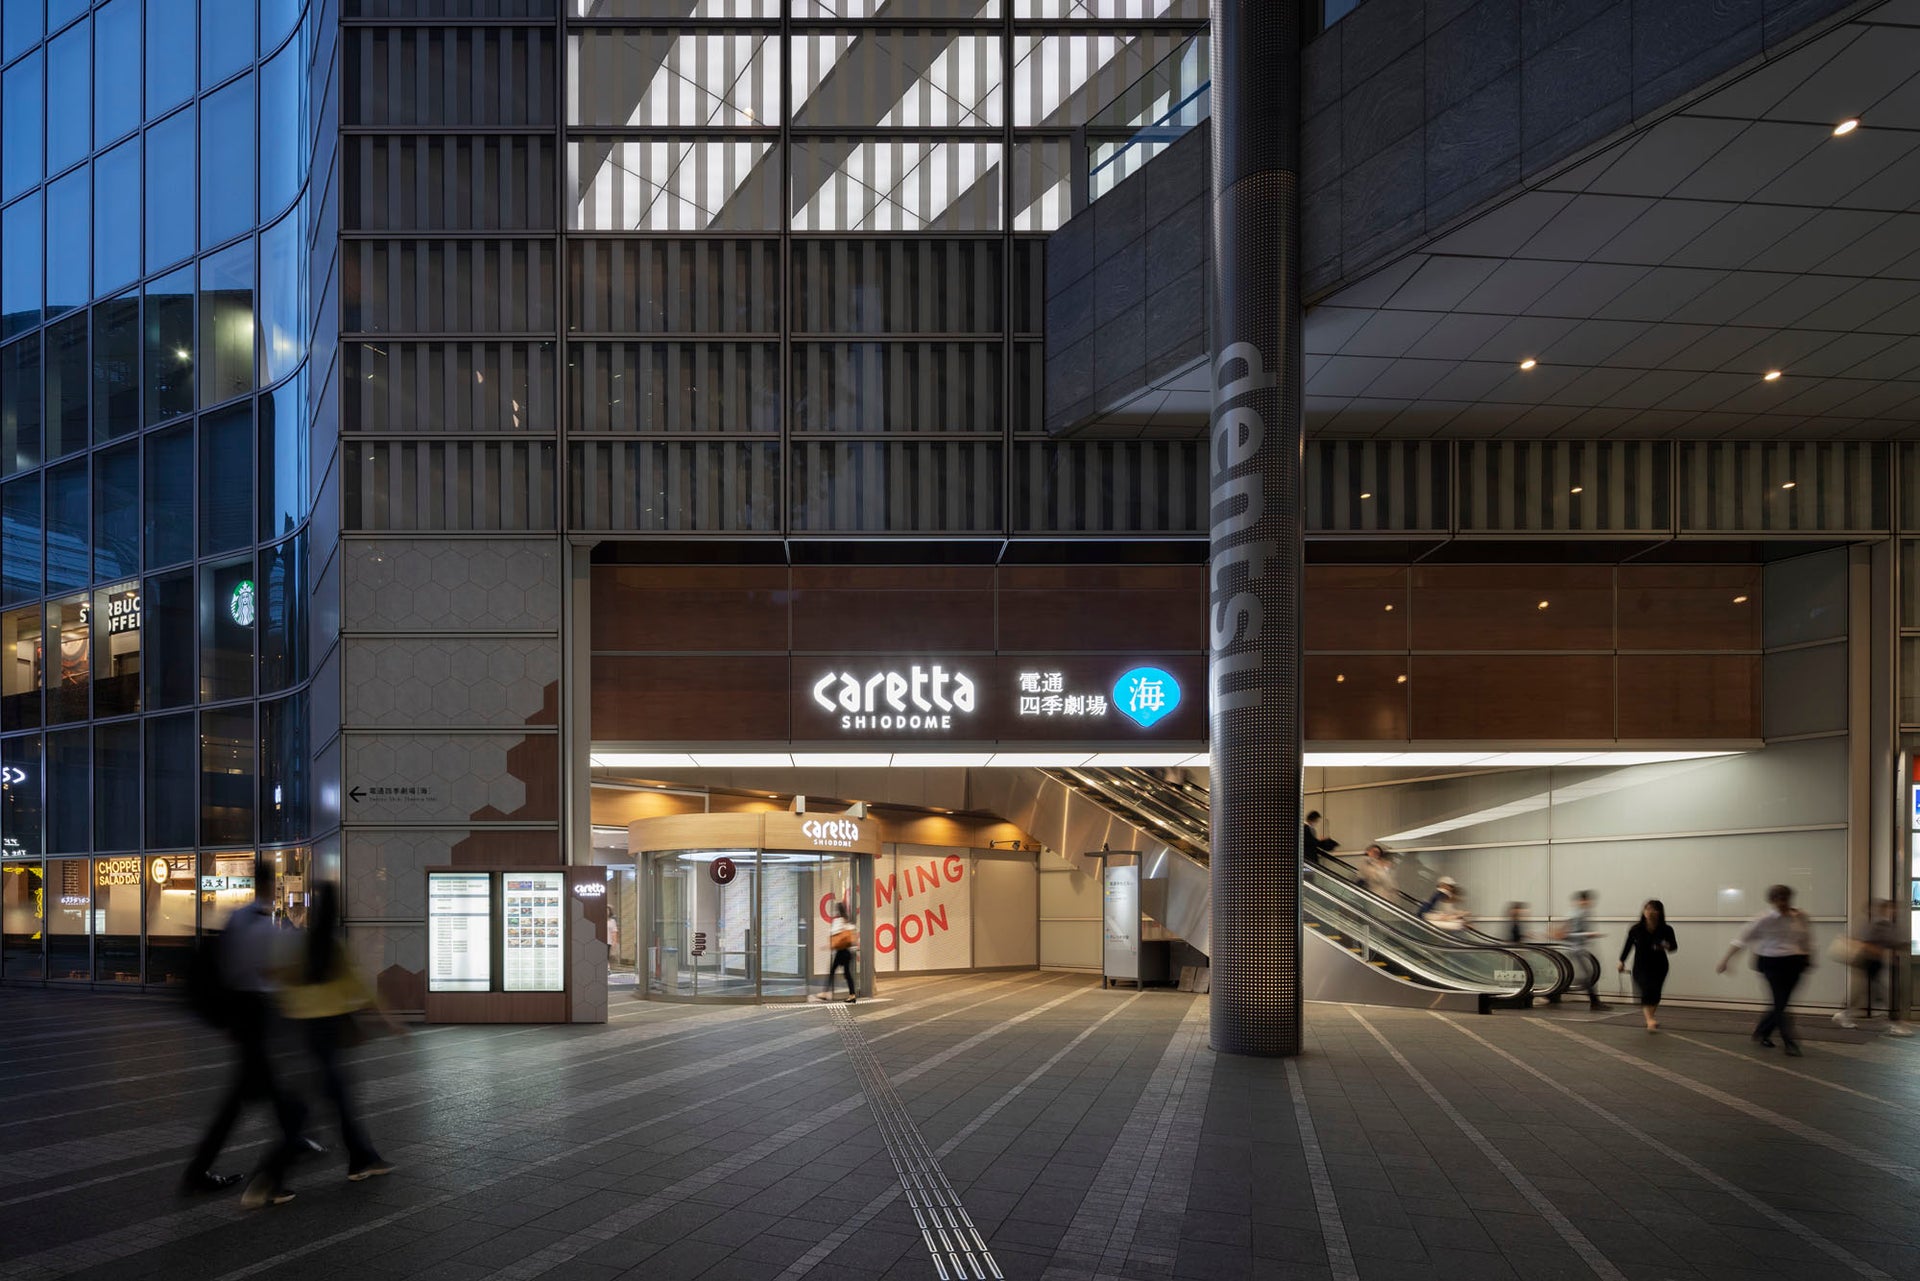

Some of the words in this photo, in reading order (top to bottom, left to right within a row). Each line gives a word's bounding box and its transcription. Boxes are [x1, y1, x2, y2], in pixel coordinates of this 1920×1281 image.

[1210, 341, 1277, 715] dentsu
[813, 665, 975, 713] caretta
[1019, 672, 1064, 693] 電通
[1128, 676, 1166, 713] 海
[1019, 695, 1108, 717] 四季劇場
[841, 715, 952, 730] SHIODOME
[802, 819, 859, 841] caretta
[813, 838, 852, 848] SHIODOME
[99, 875, 125, 886] SALAD
[717, 865, 727, 879] C
[574, 883, 606, 894] caretta
[819, 854, 964, 924] CMING
